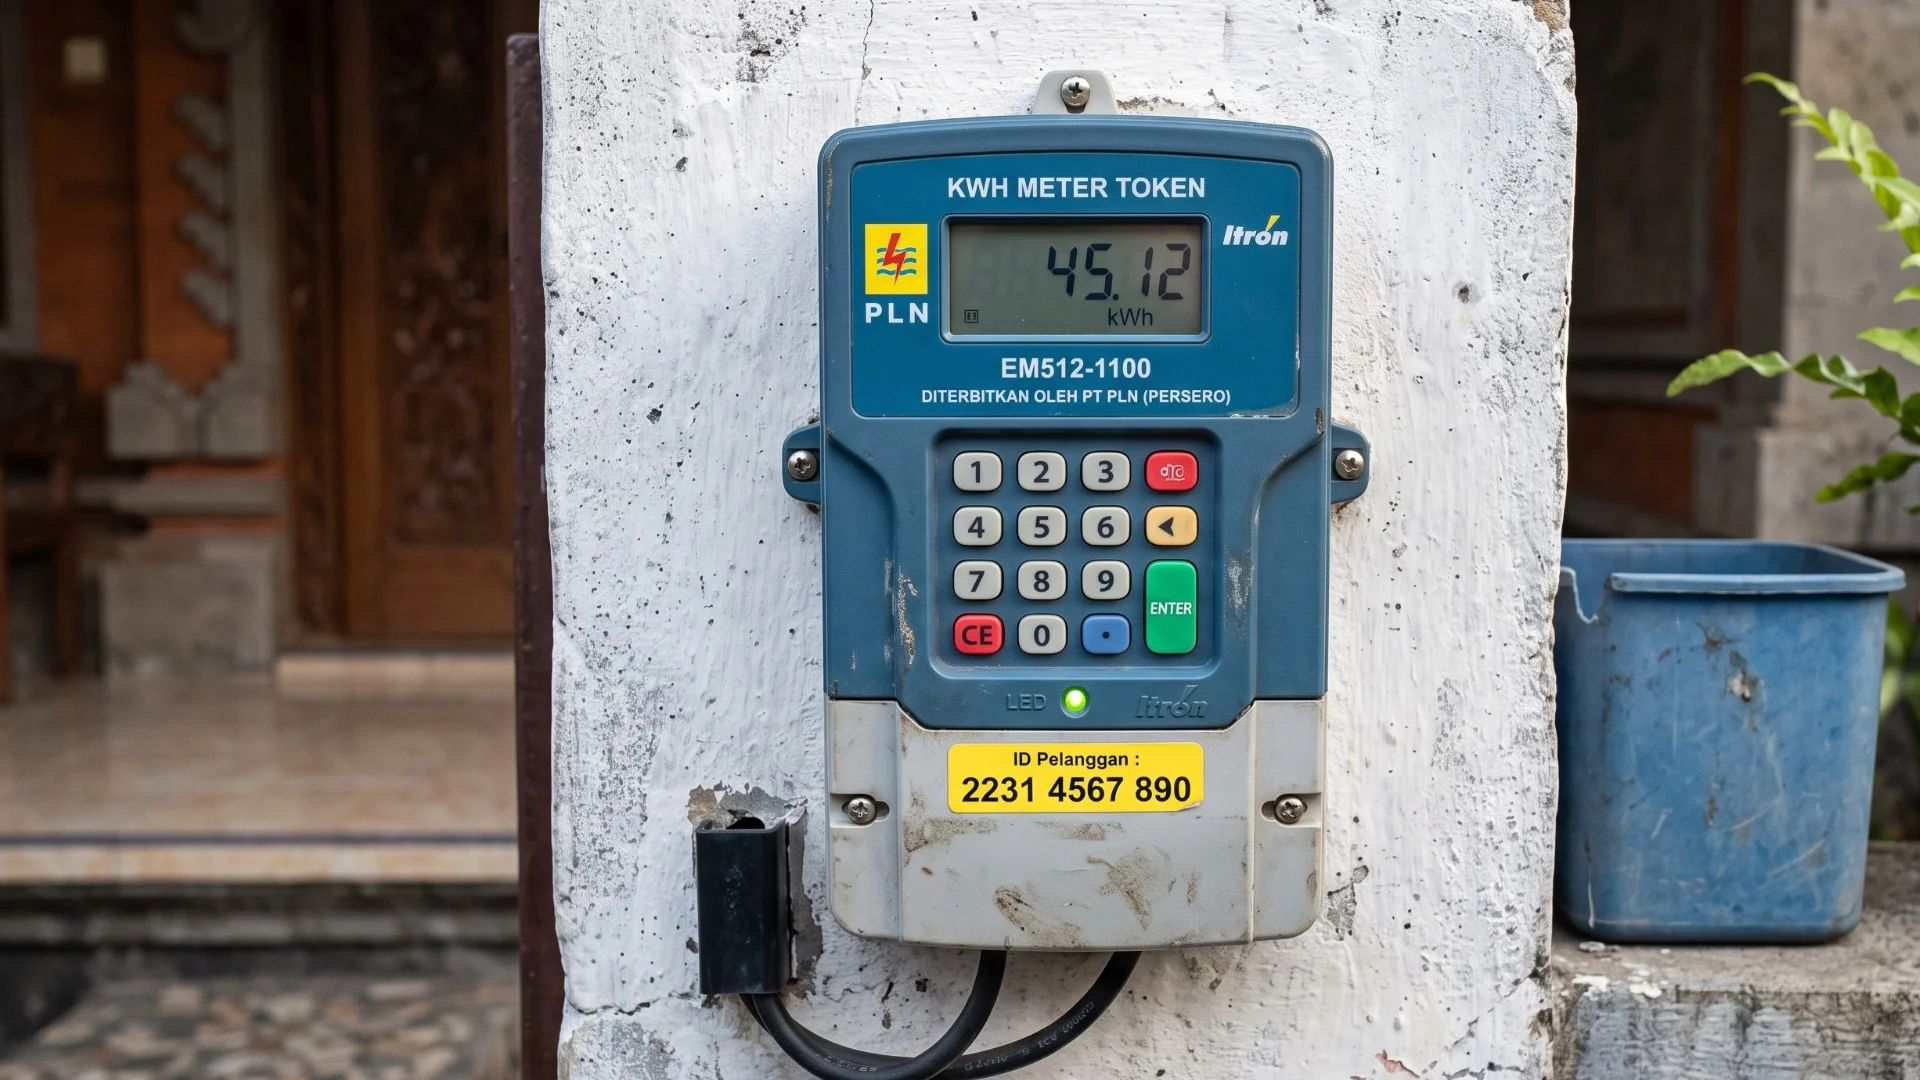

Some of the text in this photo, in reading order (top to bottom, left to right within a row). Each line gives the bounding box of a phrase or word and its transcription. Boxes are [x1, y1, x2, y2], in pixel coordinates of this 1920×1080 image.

[948, 176, 1205, 198] KWH METER TOKEN
[1047, 243, 1192, 301] 45.12
[865, 302, 929, 324] PLN
[1107, 308, 1154, 327] kWh
[1001, 357, 1151, 379] EM512-1100
[921, 389, 1231, 406] DITERBITKAN OLEH PT PLN (PERSERO)
[970, 461, 982, 483] 1
[1033, 460, 1050, 483] 2
[1098, 460, 1114, 483] 3
[967, 516, 986, 539] 4
[1033, 515, 1050, 539] 5
[1097, 515, 1115, 539] 6
[968, 570, 985, 593] 7
[1033, 570, 1050, 593] 8
[1097, 569, 1115, 593] 9
[1150, 602, 1193, 615] ENTER
[961, 625, 993, 646] CE
[1033, 624, 1051, 647] 0
[1006, 694, 1046, 711] LED
[1013, 752, 1032, 767] ID
[1037, 751, 1129, 770] Pelanggan
[962, 776, 1191, 803] 2231 4567 890
